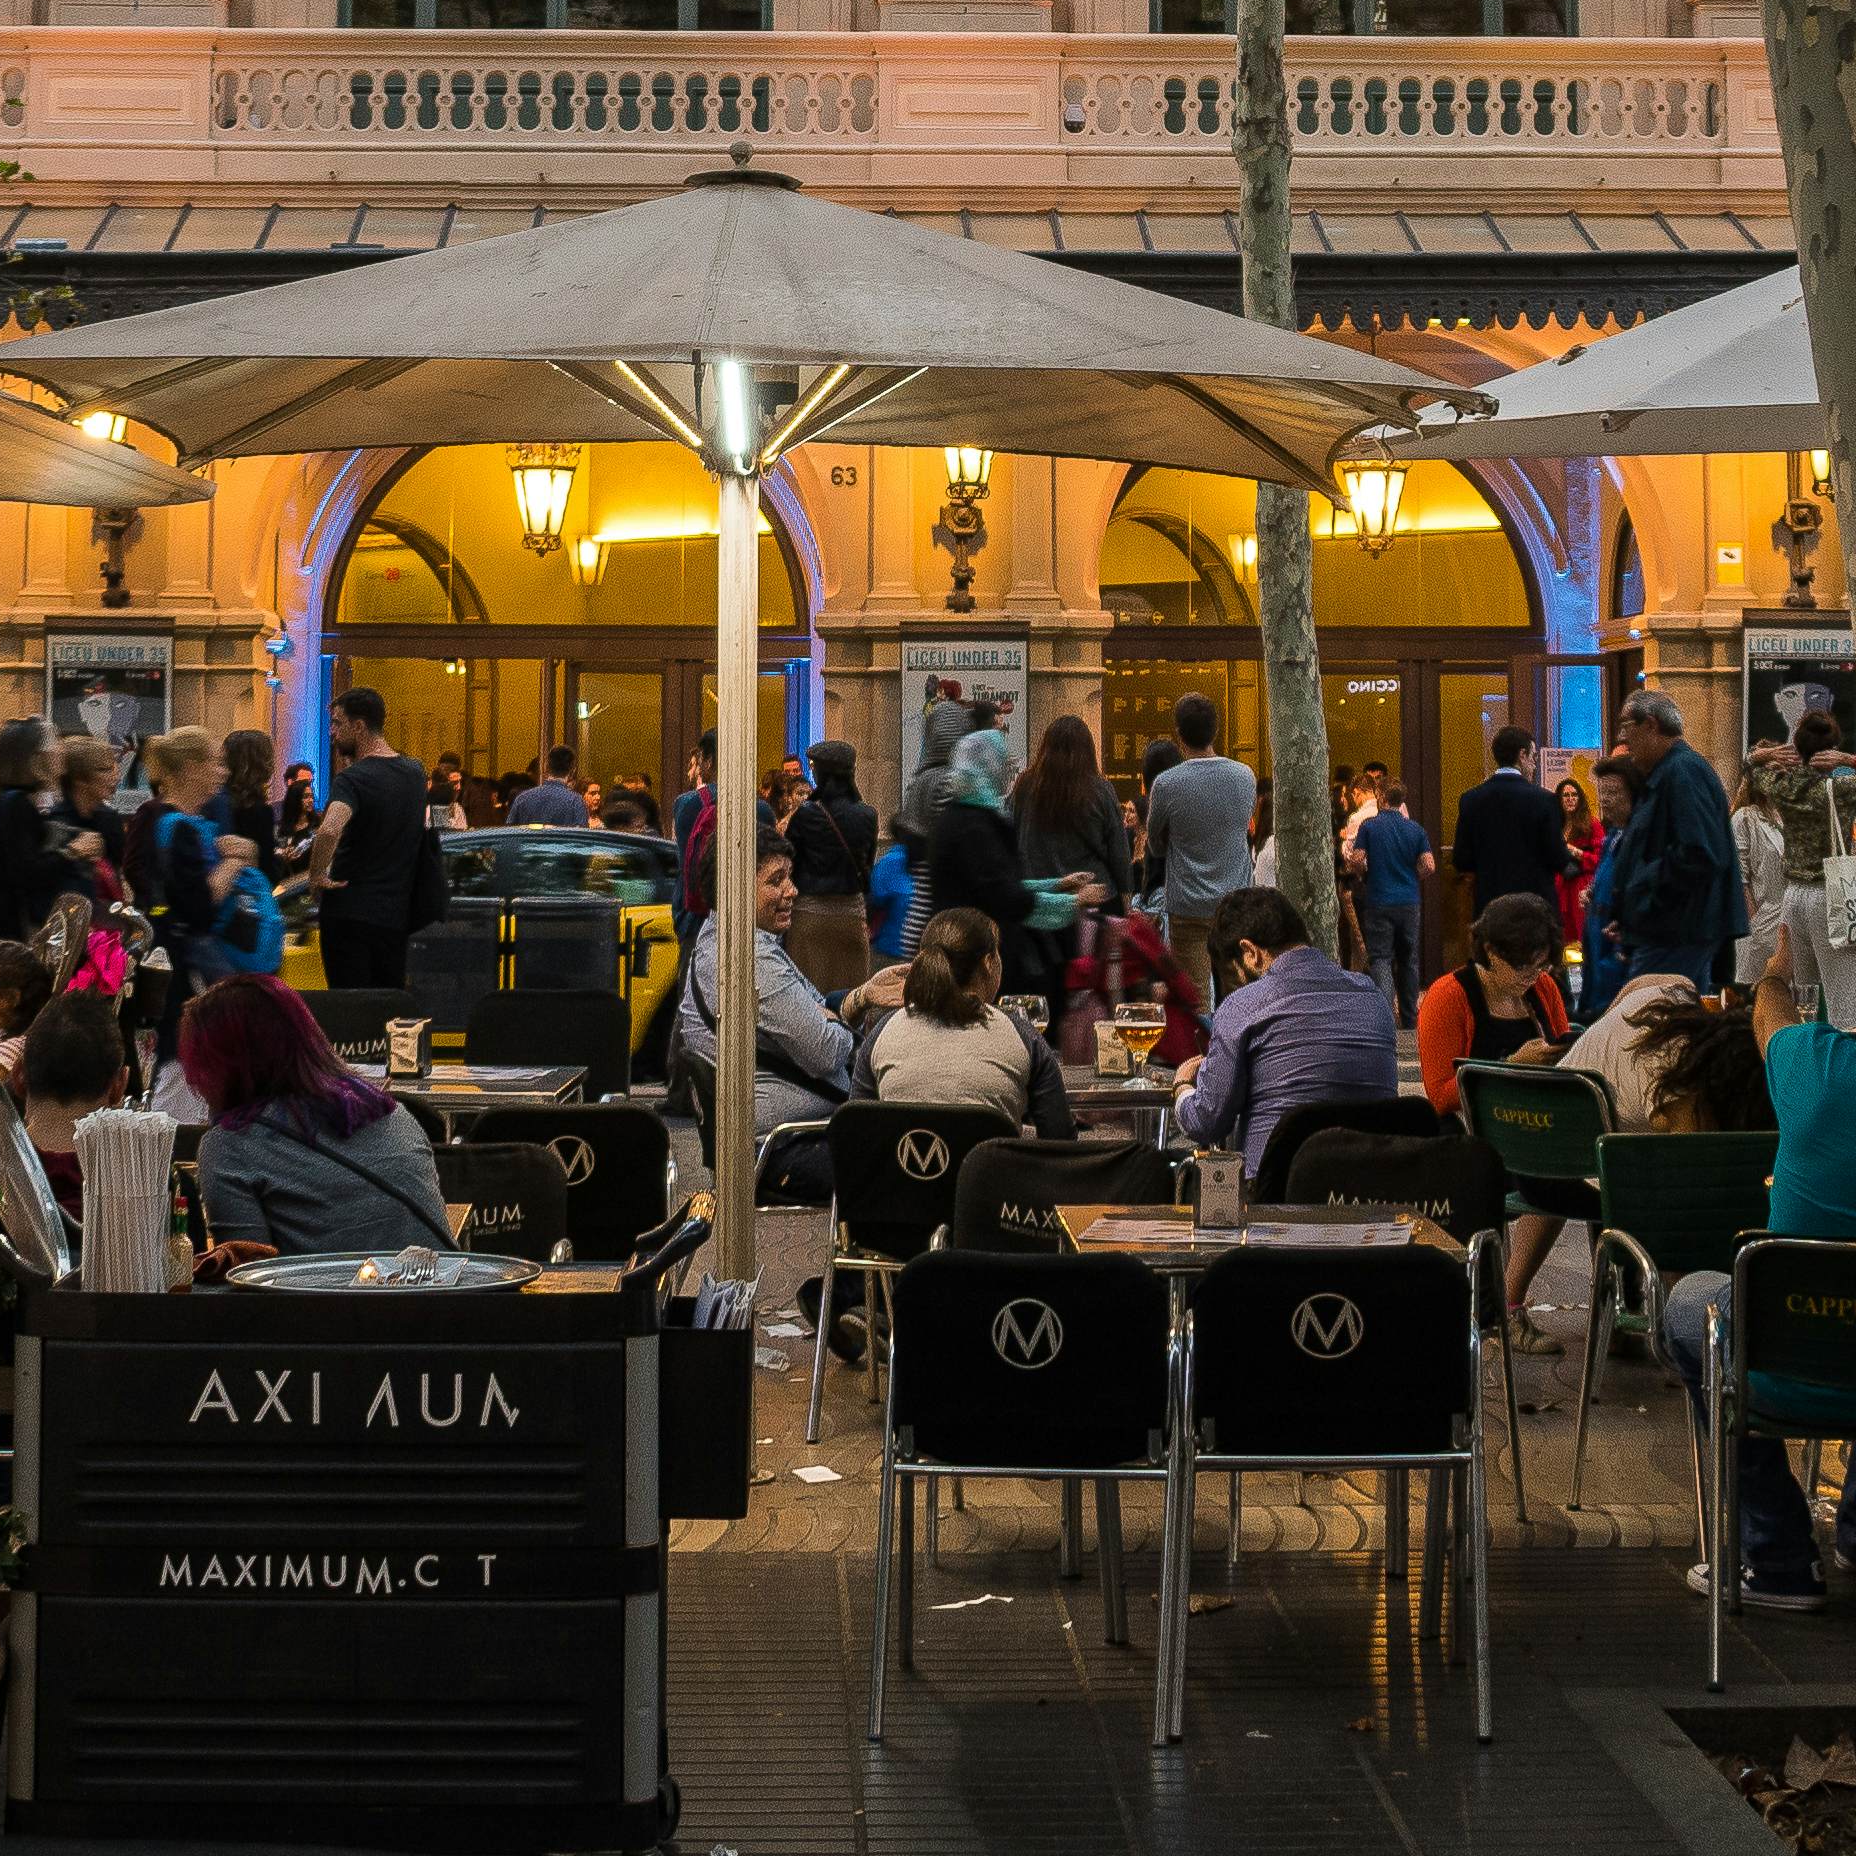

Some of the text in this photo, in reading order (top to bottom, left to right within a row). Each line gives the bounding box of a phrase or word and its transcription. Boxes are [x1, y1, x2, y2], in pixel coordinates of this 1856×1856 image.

[831, 466, 857, 486] 63
[1748, 637, 1852, 653] LICEU UNDER 3
[906, 649, 1022, 666] LICEU UNDER 35
[995, 1301, 1060, 1364] M
[1294, 1296, 1361, 1354] M
